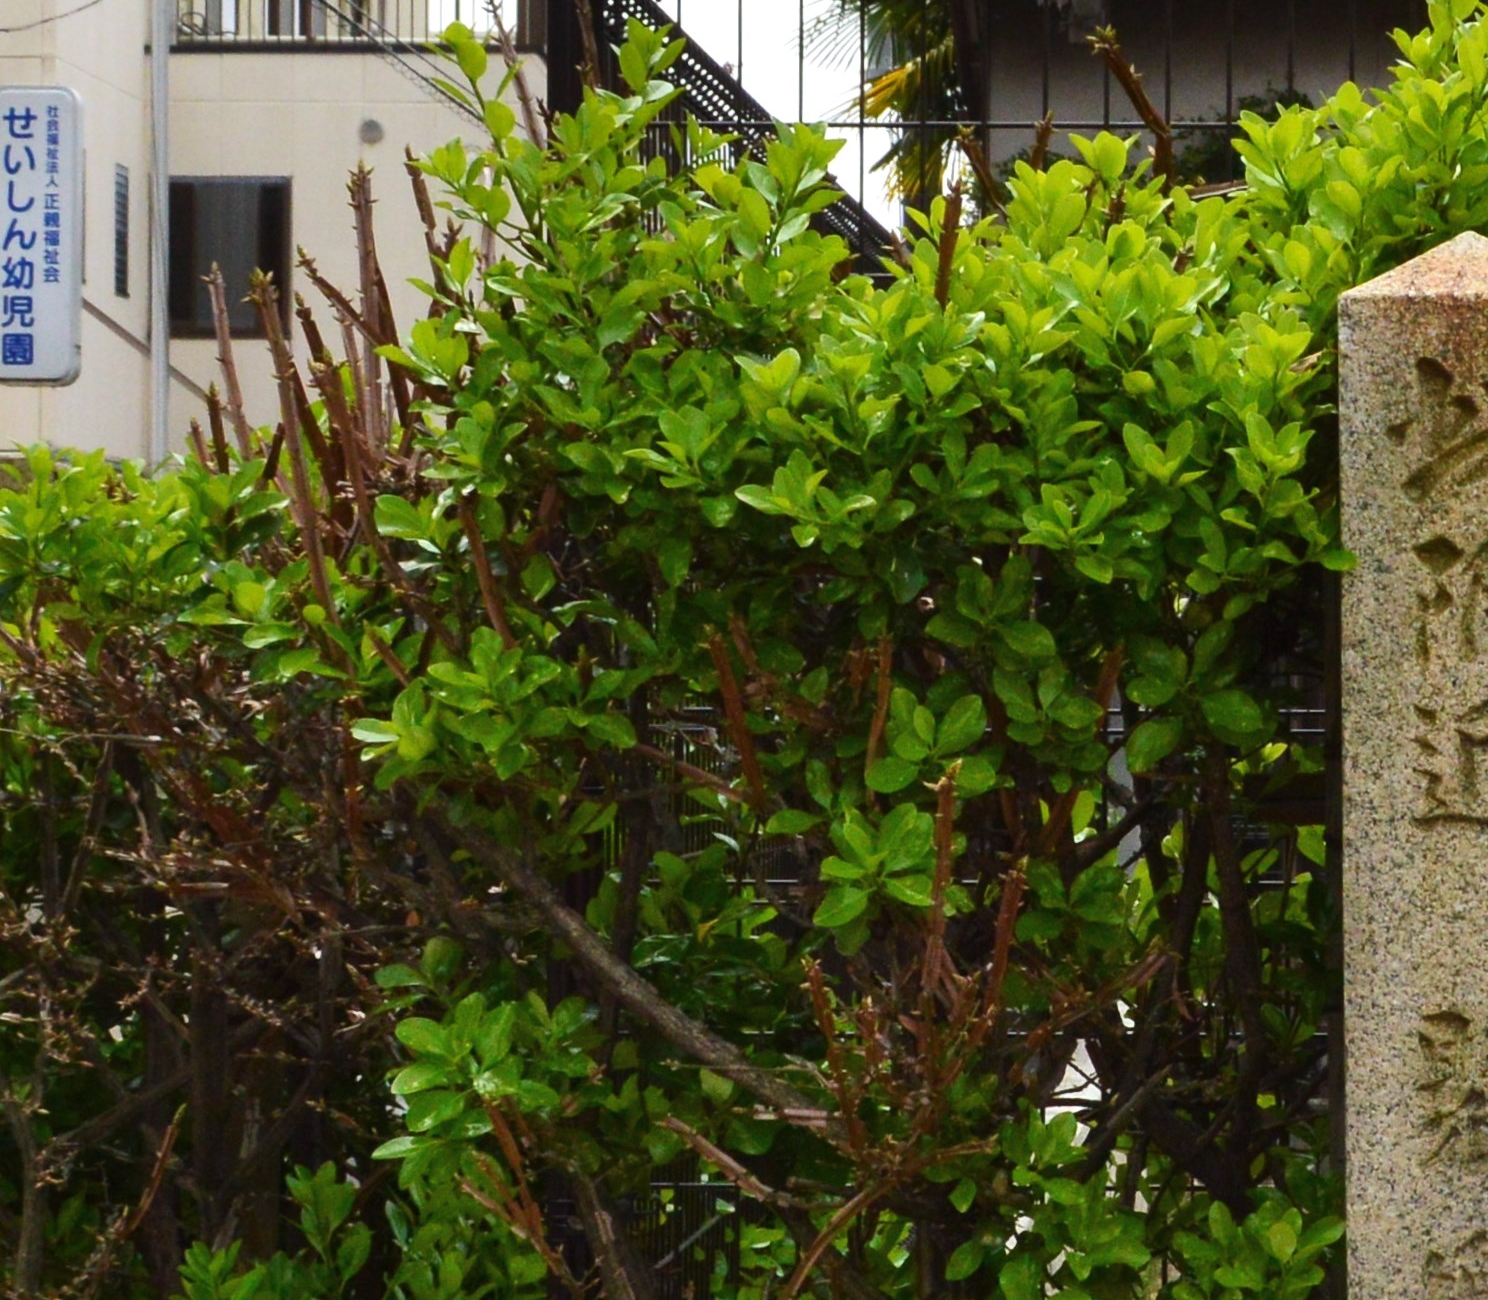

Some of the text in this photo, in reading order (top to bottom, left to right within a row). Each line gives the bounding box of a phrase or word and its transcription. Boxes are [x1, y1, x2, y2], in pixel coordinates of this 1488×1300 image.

[46, 105, 59, 188] 社会福祉法人
[1, 107, 38, 366] せいしん幼児園
